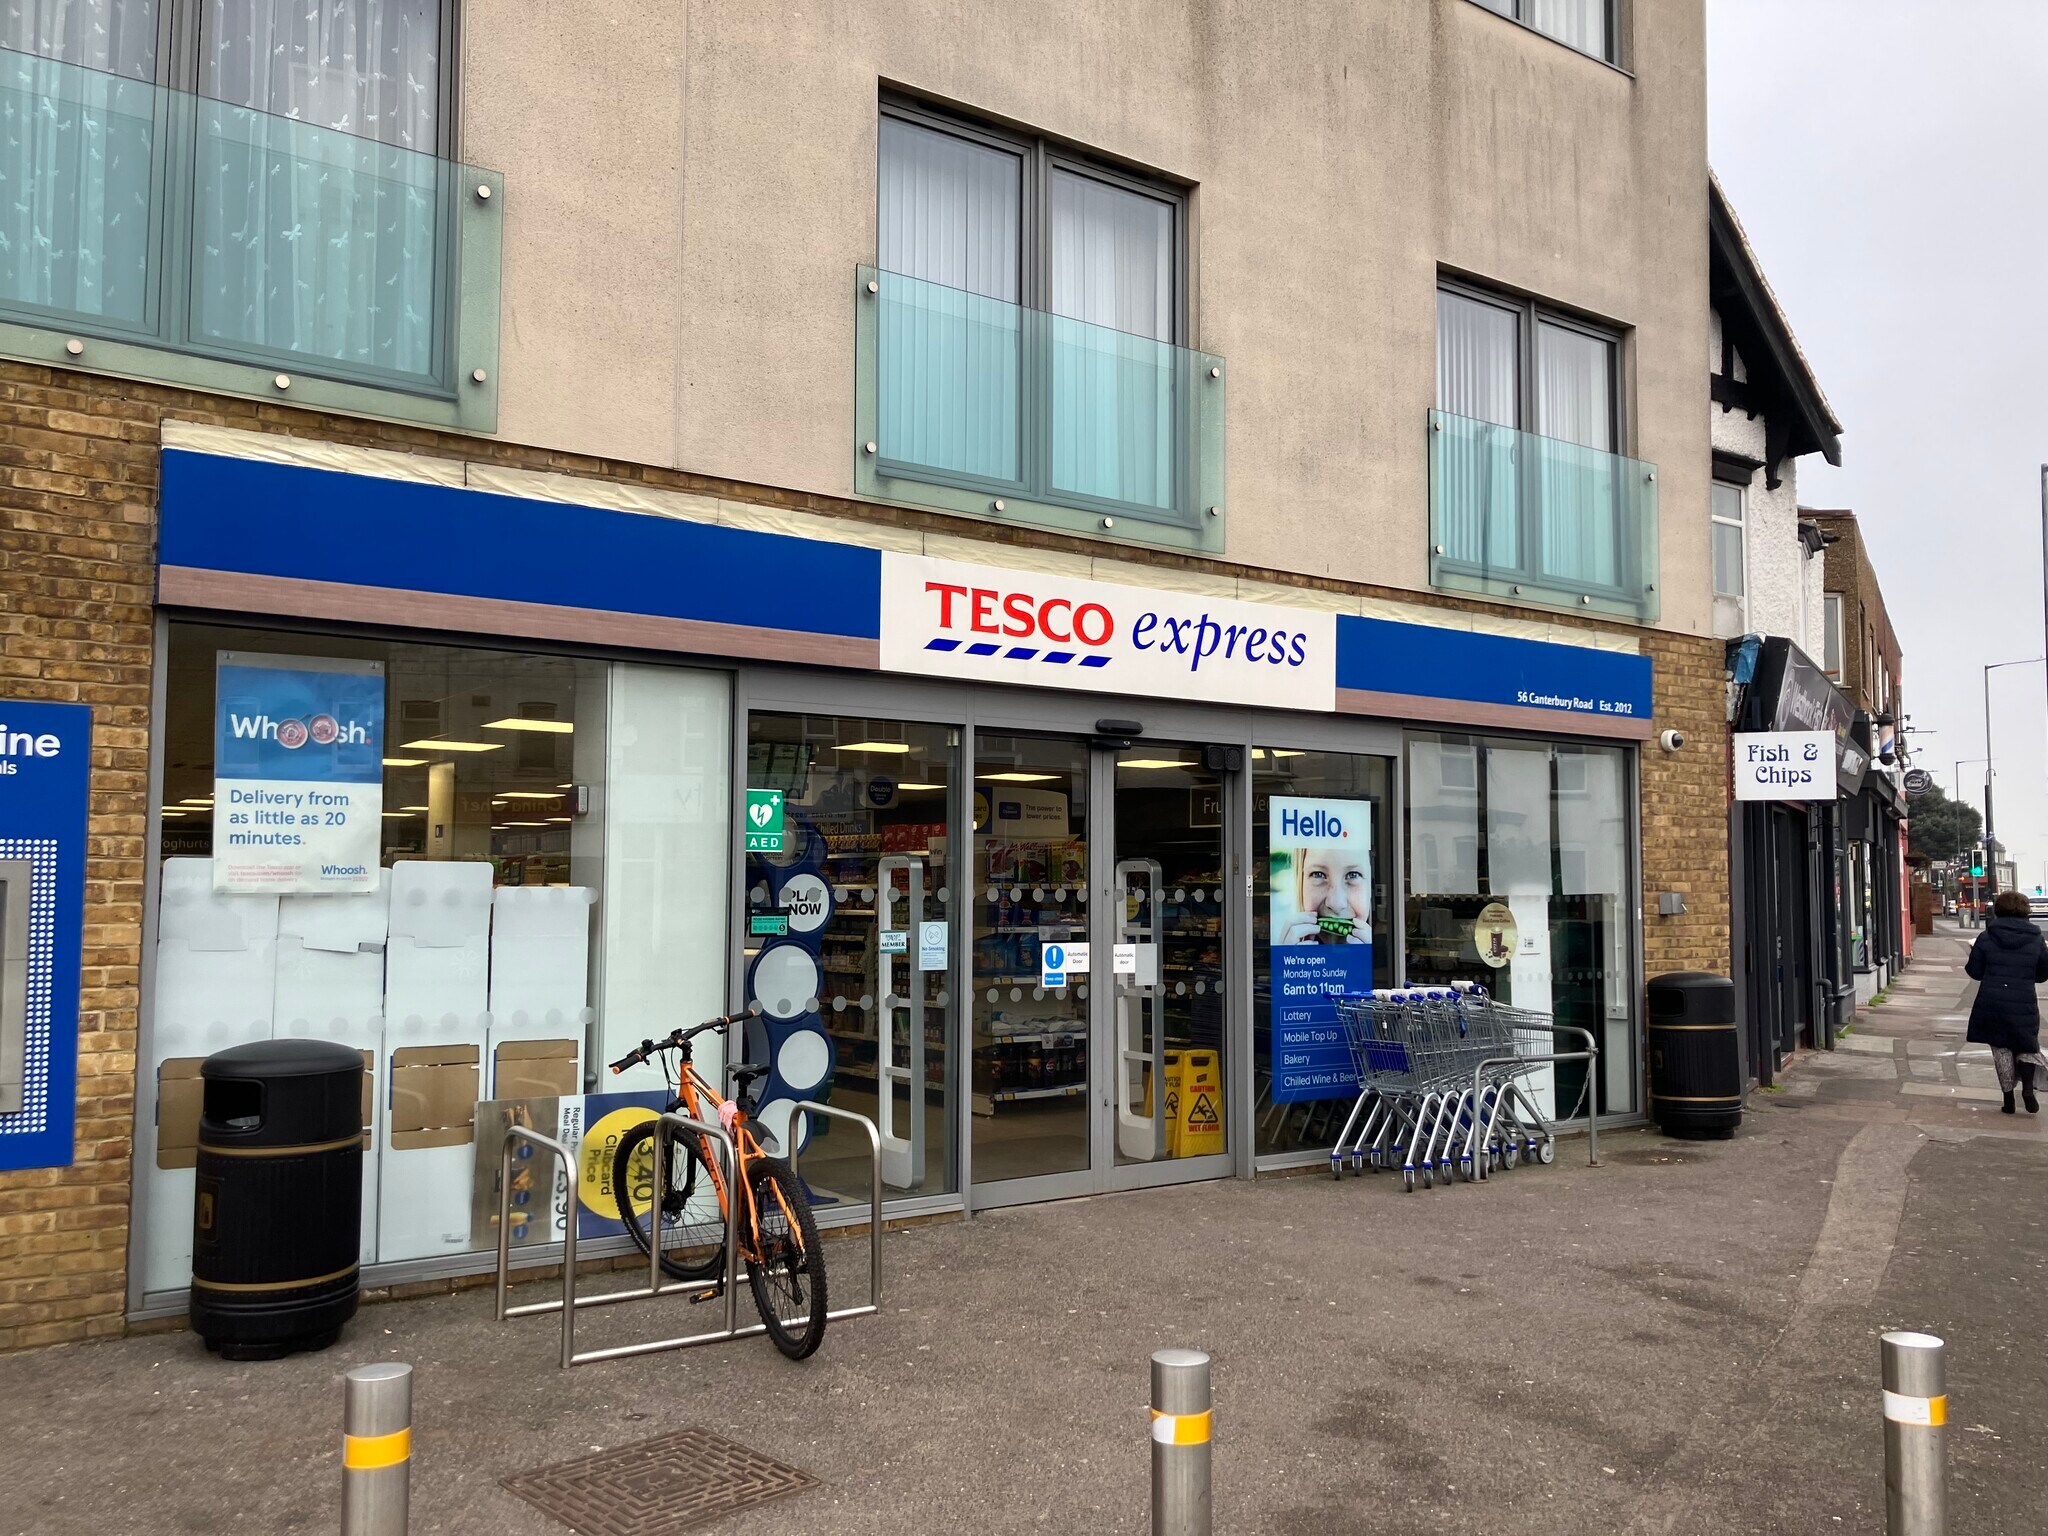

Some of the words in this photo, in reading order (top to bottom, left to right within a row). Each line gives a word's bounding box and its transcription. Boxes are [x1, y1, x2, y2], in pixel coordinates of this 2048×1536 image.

[925, 581, 1114, 646] TESCO
[1133, 611, 1307, 672] express
[1517, 691, 1528, 703] 56
[1529, 693, 1573, 710] Canterbury
[1574, 697, 1594, 710] Road
[1600, 700, 1613, 712] Est.
[1614, 702, 1633, 714] 2012
[1748, 744, 1789, 762] Fish
[1804, 743, 1818, 761] &
[1755, 765, 1812, 787] Chips
[230, 789, 303, 808] Delivery
[308, 791, 349, 806] from
[229, 813, 248, 824] as
[255, 810, 295, 825] little
[300, 814, 319, 825] as
[325, 812, 346, 826] 20
[1282, 809, 1348, 838] Hello.
[161, 838, 209, 851] oghurts
[229, 830, 306, 845] minutes.
[750, 837, 779, 848] AED
[321, 865, 368, 875] Whoosh.
[789, 889, 822, 900] PL
[788, 903, 822, 916] NOW
[1283, 956, 1305, 965] We're
[1306, 956, 1326, 966] open
[1283, 969, 1312, 979] Monday
[1312, 970, 1320, 978] to
[1322, 968, 1347, 979] Sunday
[1283, 983, 1305, 996] 6am
[1307, 983, 1318, 995] to
[1319, 982, 1345, 995] 11pm
[1283, 1011, 1312, 1022] Lottery
[1283, 1031, 1309, 1043] Mobile
[1310, 1031, 1326, 1042] Top
[1326, 1030, 1338, 1041] Up
[1284, 1054, 1311, 1065] Bakery
[1284, 1075, 1311, 1087] Chilled
[1311, 1074, 1331, 1085] Wine
[1332, 1073, 1338, 1083] &
[563, 1107, 571, 1126] Meal
[571, 1107, 581, 1139] Regular
[586, 1149, 601, 1183] Price
[600, 1134, 618, 1196] Clubcard
[633, 1141, 655, 1202] 3.40
